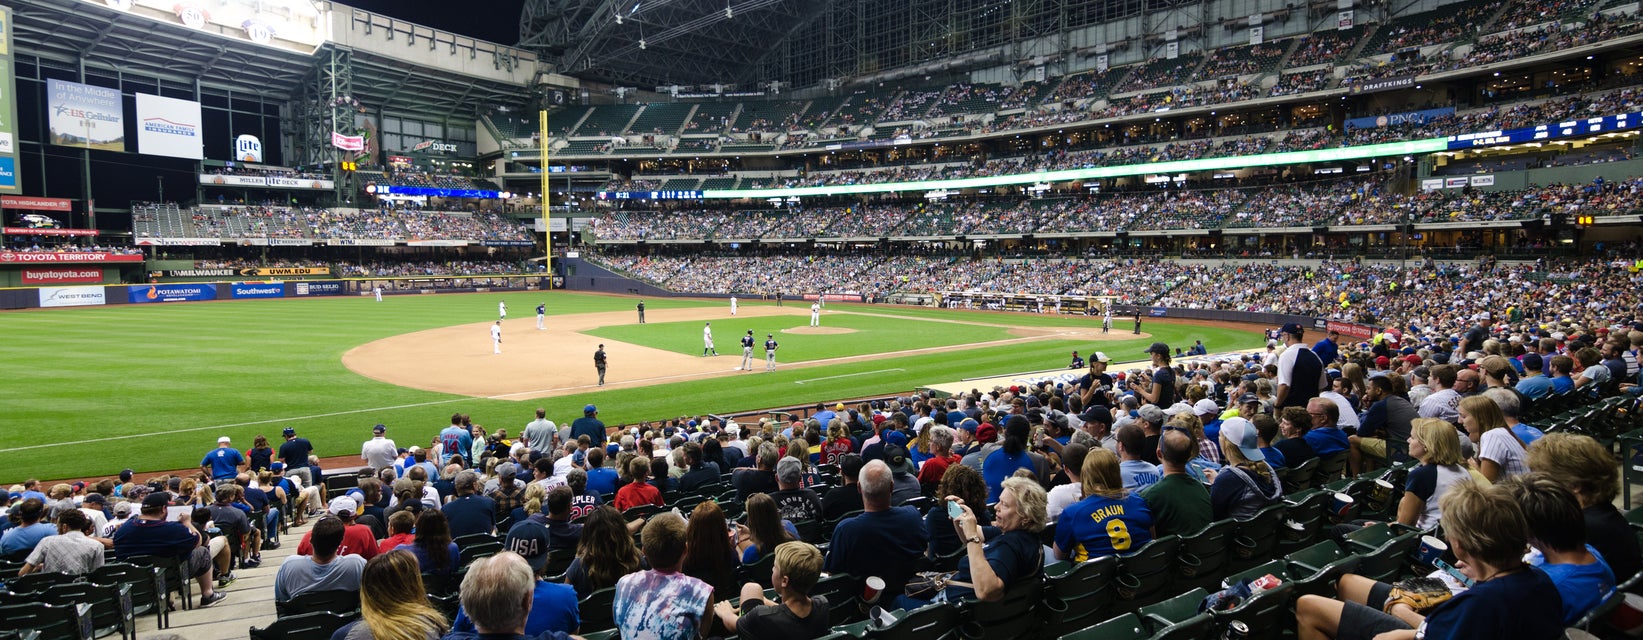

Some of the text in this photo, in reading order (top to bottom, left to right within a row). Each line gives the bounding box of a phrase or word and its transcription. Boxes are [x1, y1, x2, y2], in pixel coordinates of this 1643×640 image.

[55, 81, 116, 99] In the Middle
[1363, 78, 1412, 91] DRAFTKINGS
[56, 91, 115, 107] of Anywhere
[85, 111, 120, 123] Cellular
[1389, 112, 1418, 126] PNC
[145, 121, 175, 130] AMERICAN
[240, 140, 259, 153] Lite
[432, 143, 457, 152] DECK
[265, 176, 281, 187] Lite
[615, 191, 630, 199] 9:21
[18, 200, 58, 208] HIGHLANDER
[267, 238, 281, 246] Lite
[18, 253, 57, 261] TOYOTA
[26, 270, 100, 280] buyatoyota.com
[236, 287, 275, 296] Southwest
[1333, 323, 1351, 333] TOYOTA
[443, 439, 459, 454] 14
[1090, 504, 1125, 524] BRAUN
[1105, 518, 1132, 551] 8
[510, 536, 539, 556] USA
